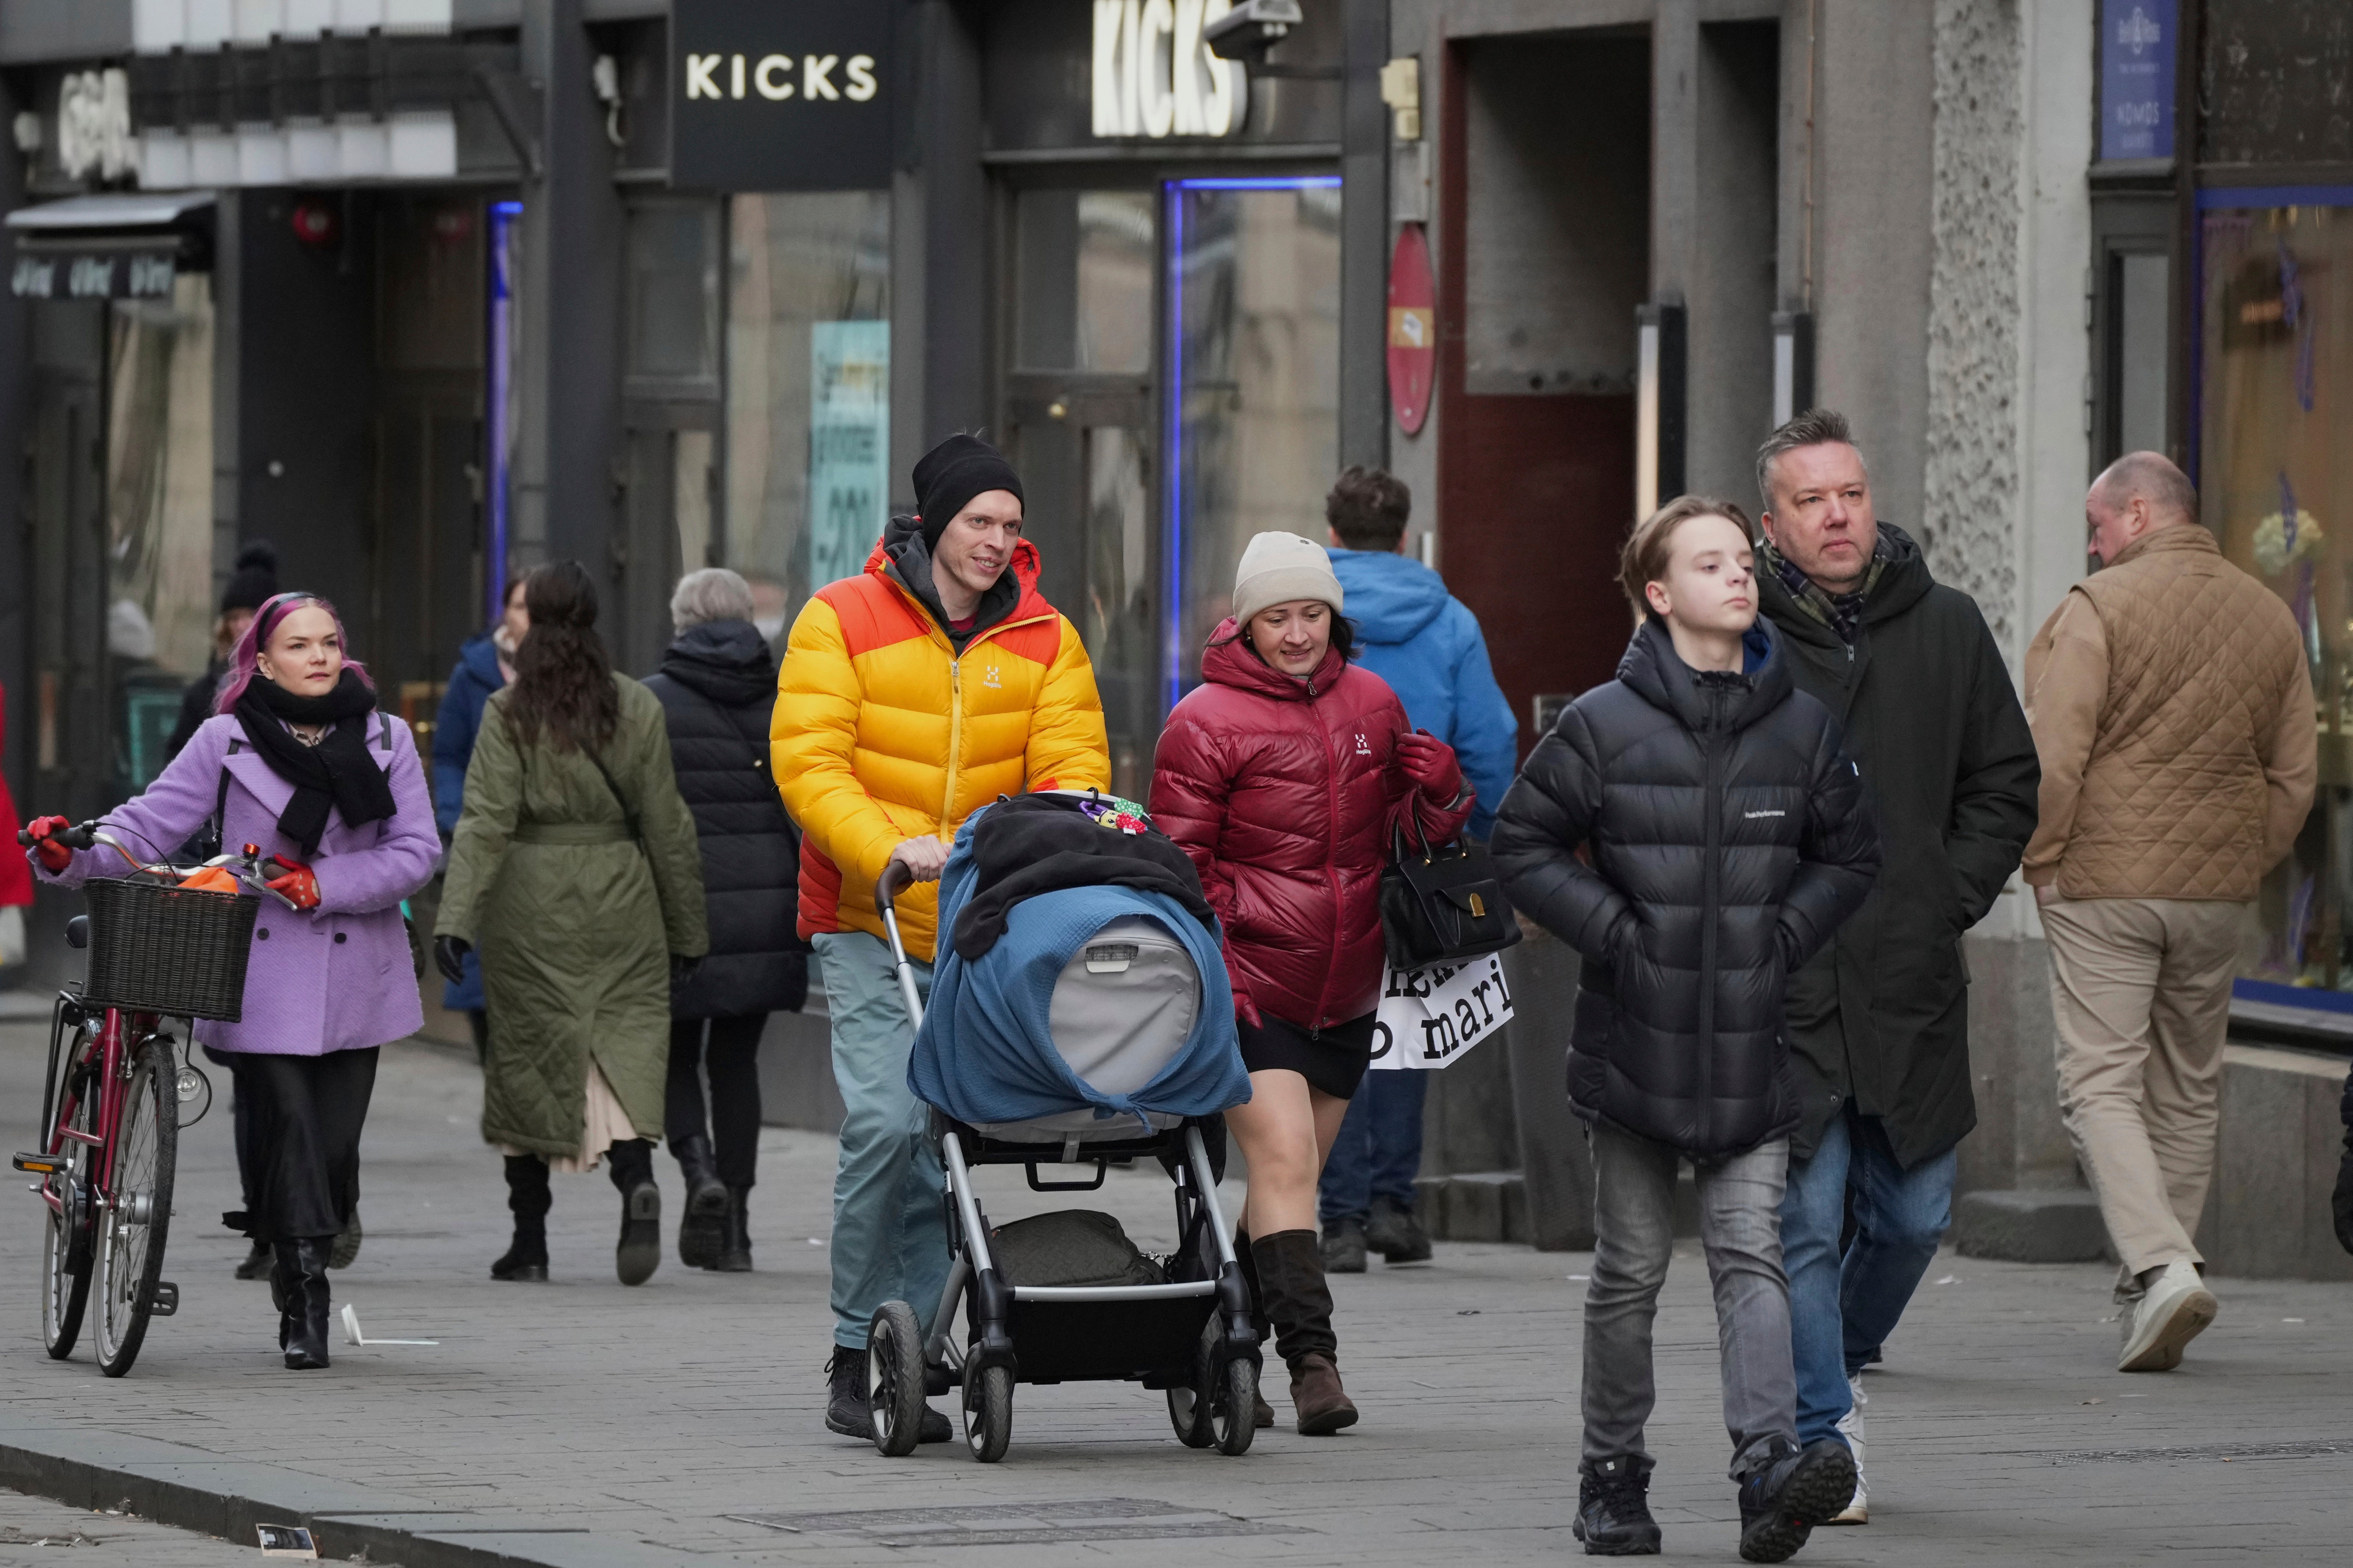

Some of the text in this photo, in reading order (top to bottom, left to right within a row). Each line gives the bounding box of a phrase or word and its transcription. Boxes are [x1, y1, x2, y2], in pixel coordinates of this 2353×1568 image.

[686, 54, 878, 101] KICKS
[1092, 0, 1244, 137] KICKS
[1421, 959, 1512, 1059] mari
